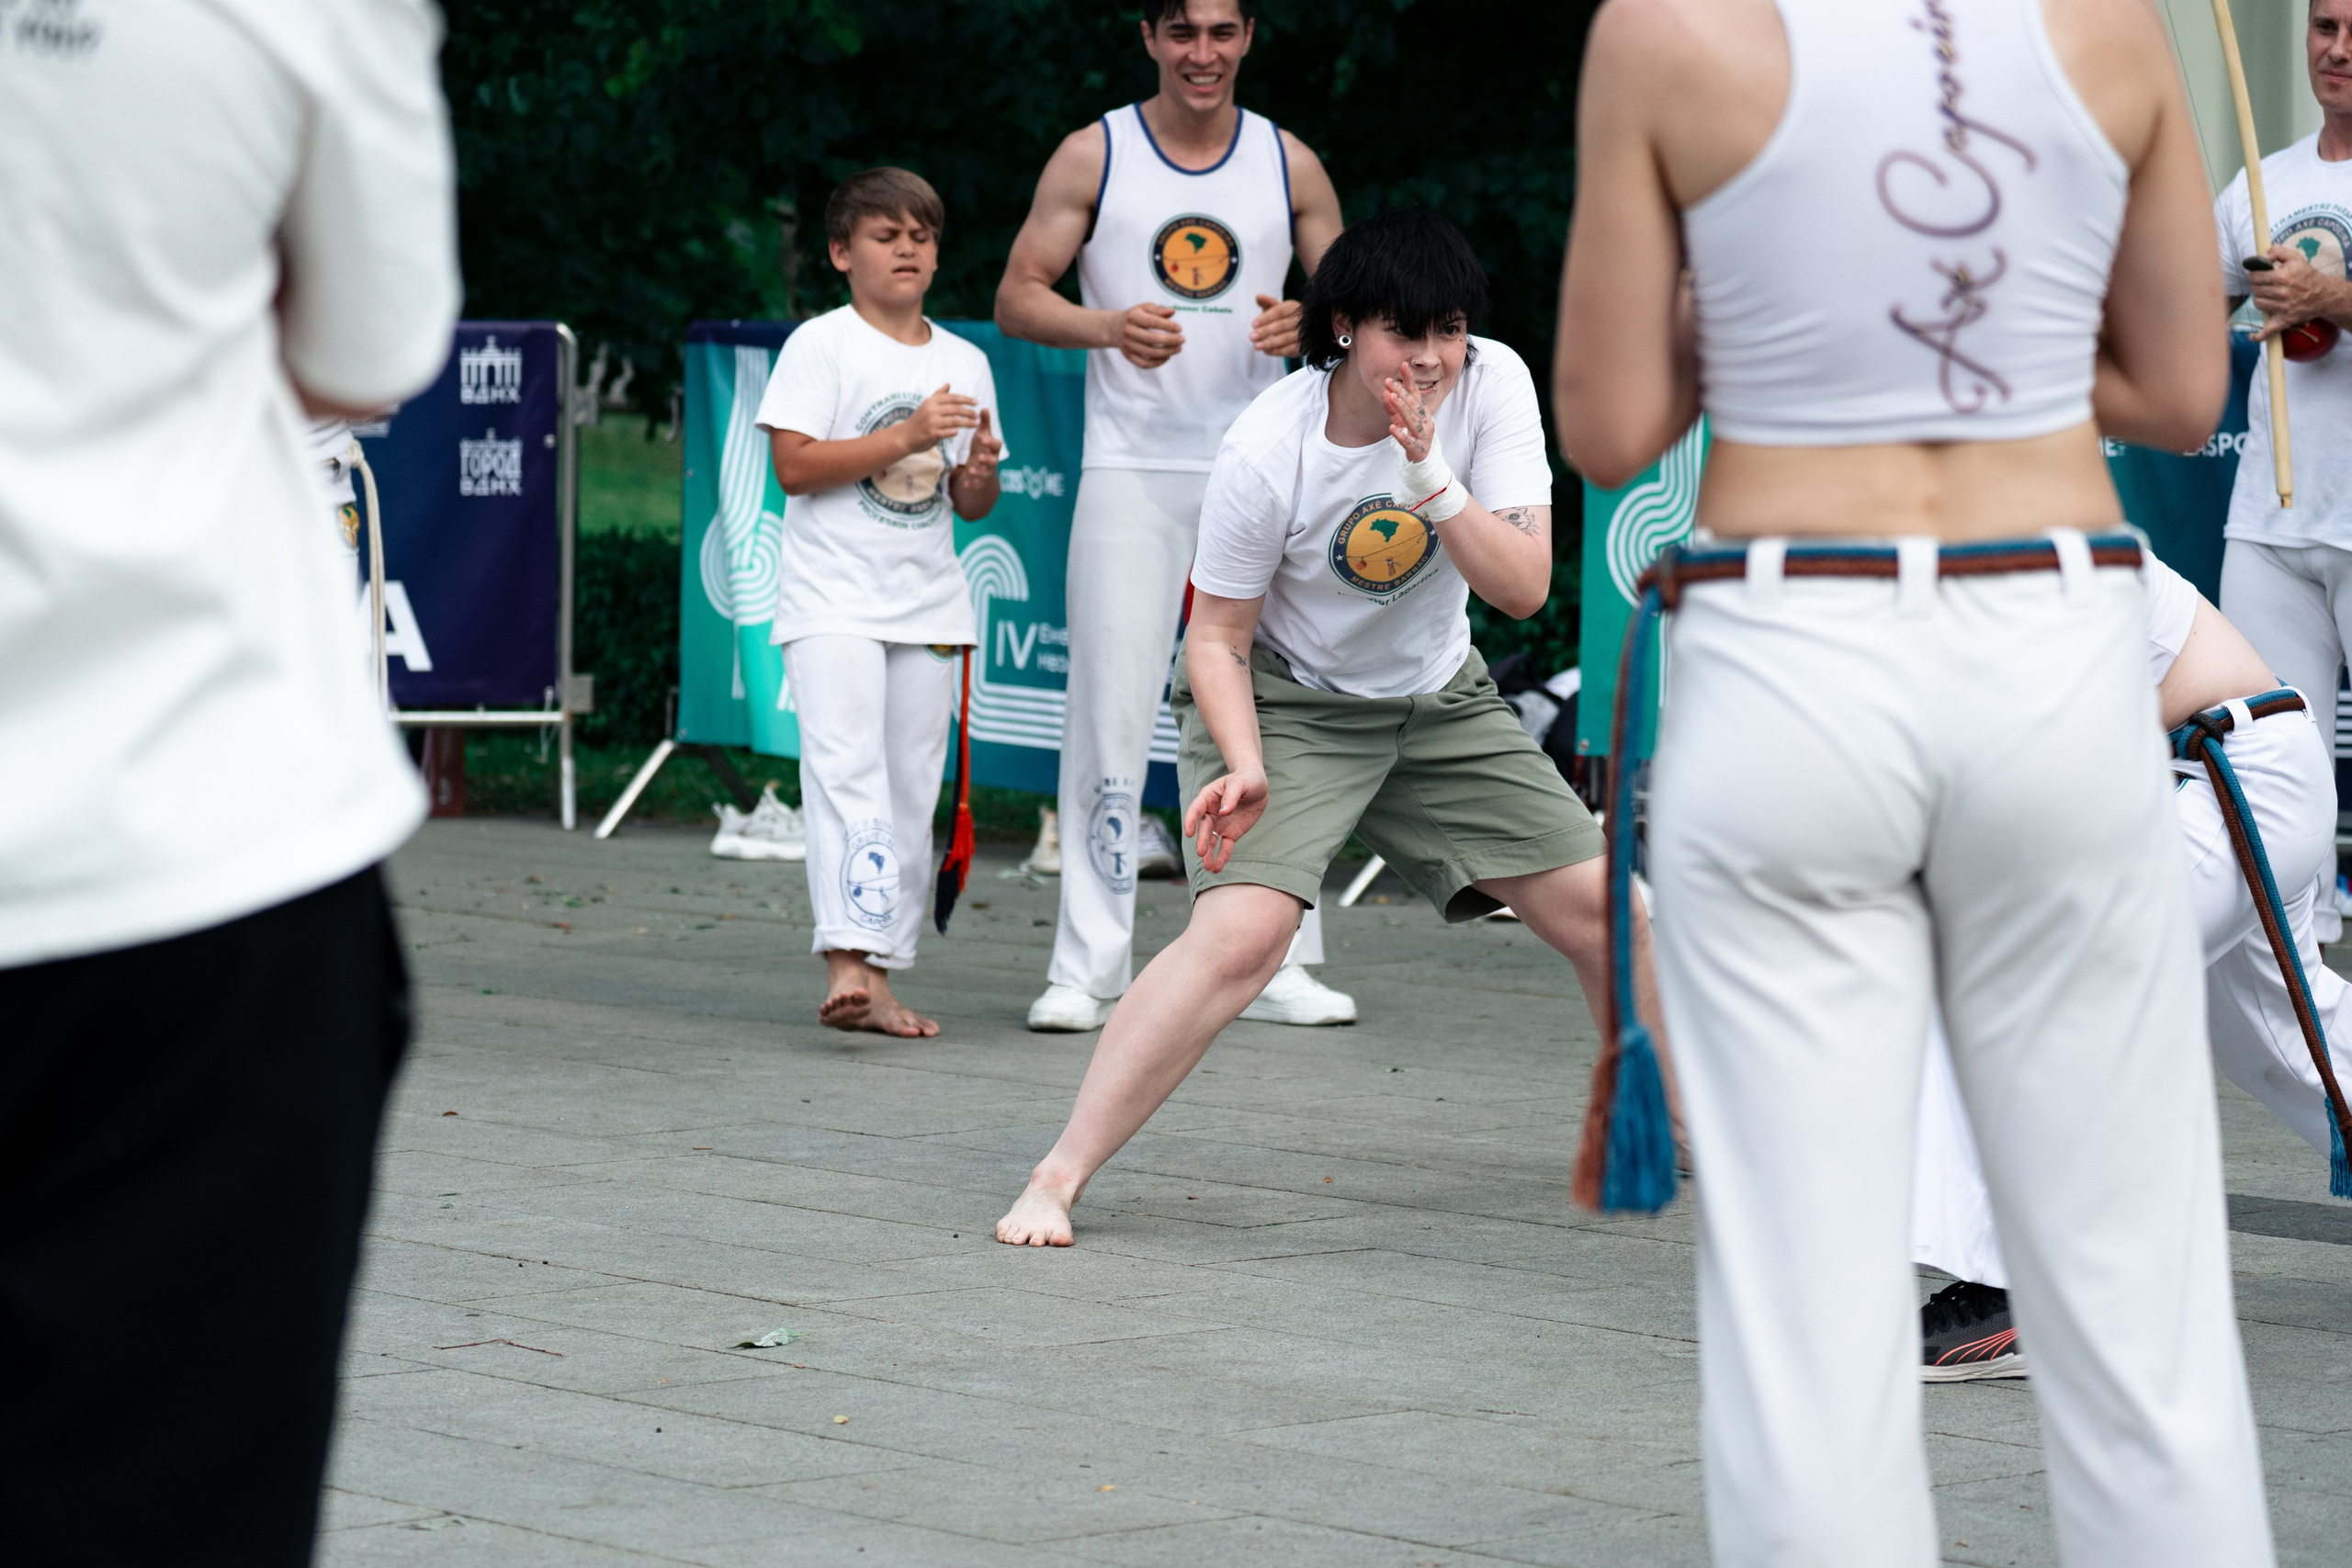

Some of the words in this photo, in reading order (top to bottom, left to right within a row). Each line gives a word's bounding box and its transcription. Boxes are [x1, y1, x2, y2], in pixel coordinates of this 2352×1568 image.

[1338, 512, 1361, 545] GRUPO
[1362, 500, 1382, 514] AXÉ
[1351, 576, 1391, 591] MESTRE
[996, 620, 1037, 670] IV
